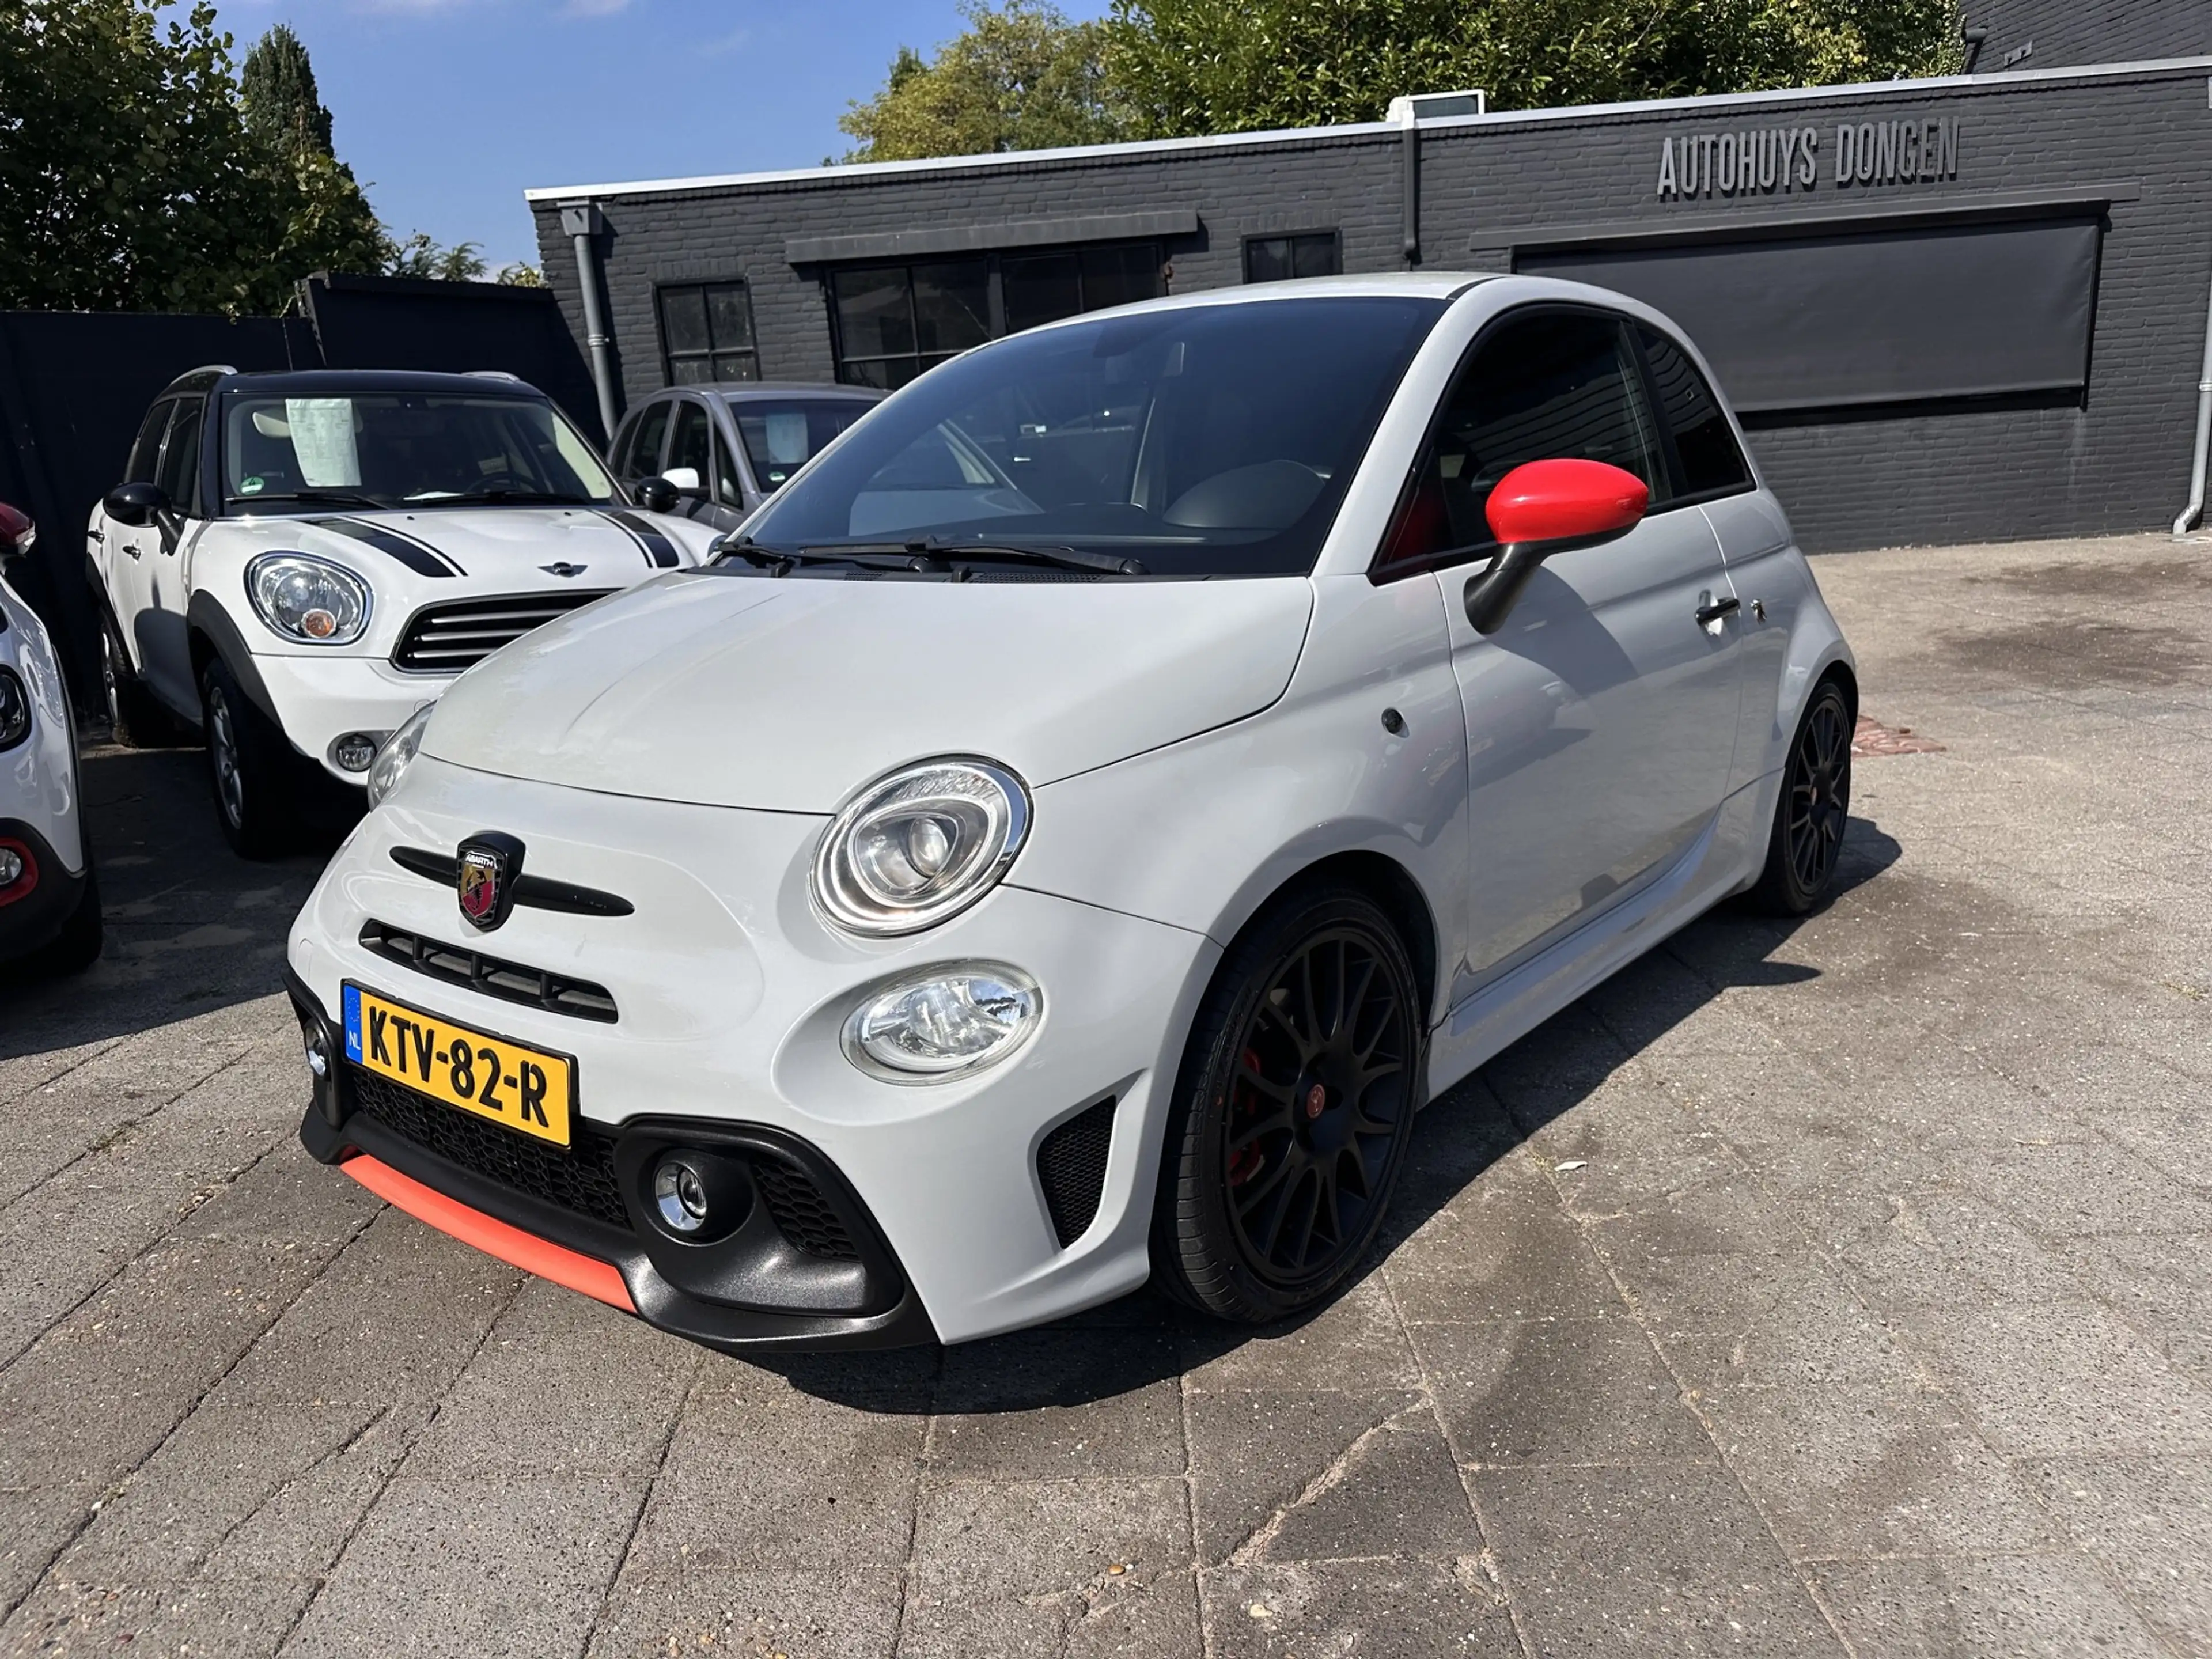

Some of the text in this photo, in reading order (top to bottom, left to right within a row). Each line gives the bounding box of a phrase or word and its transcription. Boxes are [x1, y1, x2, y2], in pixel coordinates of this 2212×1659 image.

[1657, 116, 1959, 195] AUTOHUYS DONGEN
[465, 854, 493, 867] ABARTH
[349, 1029, 361, 1050] NL
[369, 1006, 549, 1128] KTV-82-R
